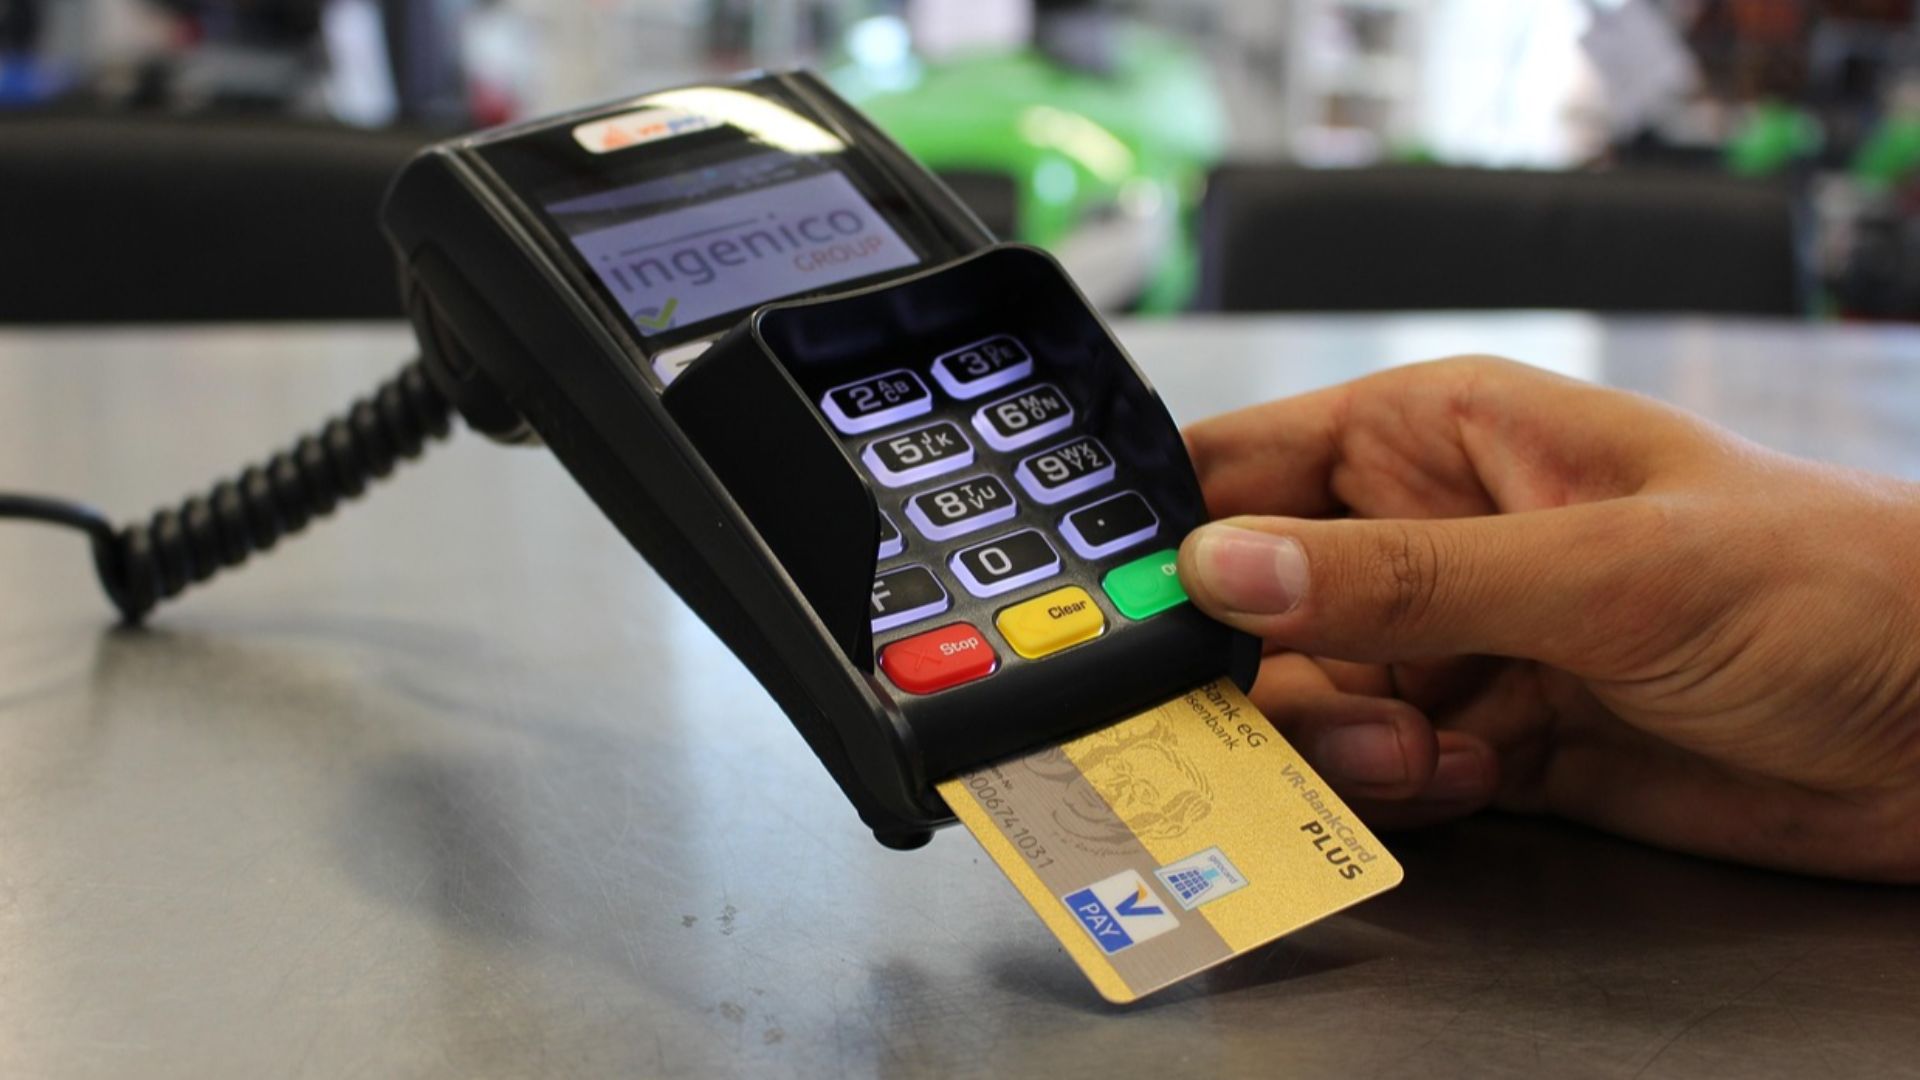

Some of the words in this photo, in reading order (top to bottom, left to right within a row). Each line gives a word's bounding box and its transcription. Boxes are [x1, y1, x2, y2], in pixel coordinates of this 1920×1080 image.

[602, 208, 864, 293] ingenico
[793, 233, 885, 274] GROUP
[958, 351, 990, 375] 3
[849, 385, 882, 412] 2
[996, 402, 1029, 429] 6
[889, 436, 924, 464] 5
[1036, 455, 1070, 482] 9
[933, 491, 968, 519] 8
[871, 580, 892, 612] F
[1046, 600, 1088, 620] Clear
[939, 636, 979, 656] Stop
[1237, 722, 1268, 748] eG
[1280, 763, 1378, 864] VR-BankCard
[1299, 820, 1364, 880] PLUS
[1079, 901, 1121, 937] PAY
